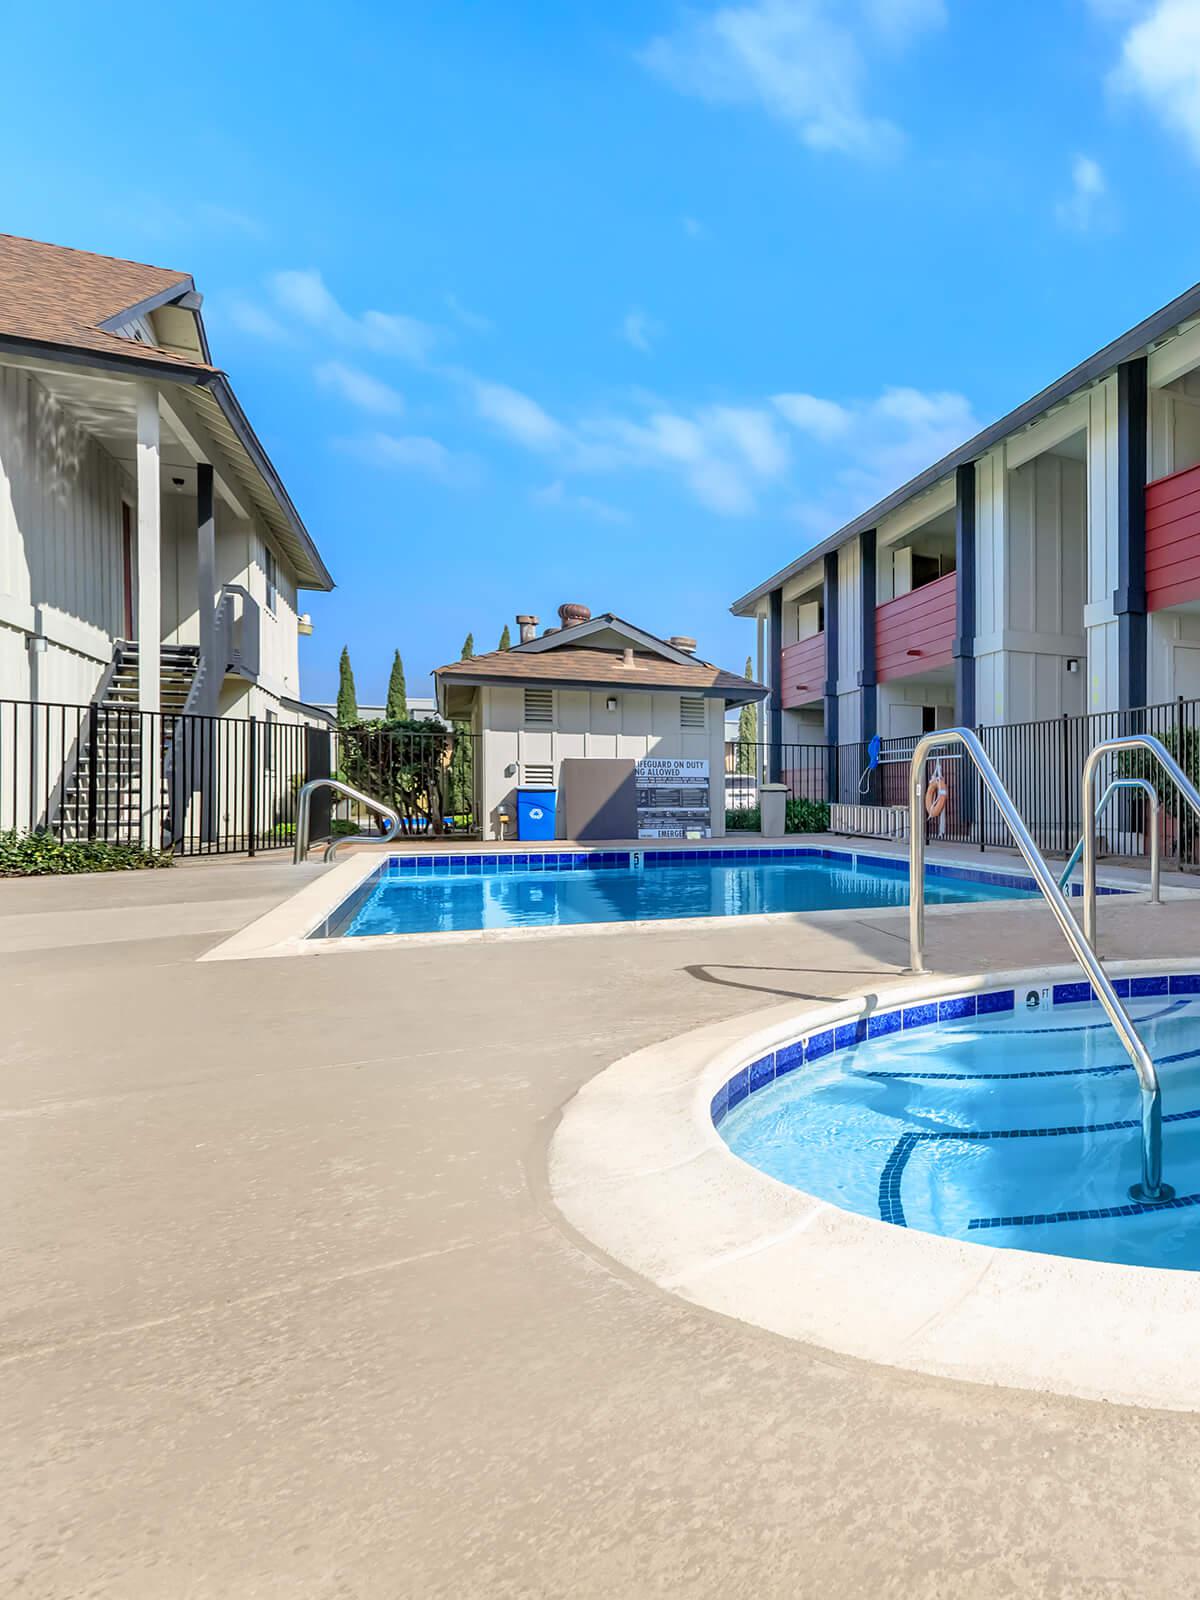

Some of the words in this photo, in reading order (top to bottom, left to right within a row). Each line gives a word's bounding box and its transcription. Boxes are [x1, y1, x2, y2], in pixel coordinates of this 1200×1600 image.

[674, 760, 685, 769] ON
[686, 760, 704, 769] DUTY
[647, 768, 681, 776] ALLOWED
[657, 829, 683, 838] EMERGE
